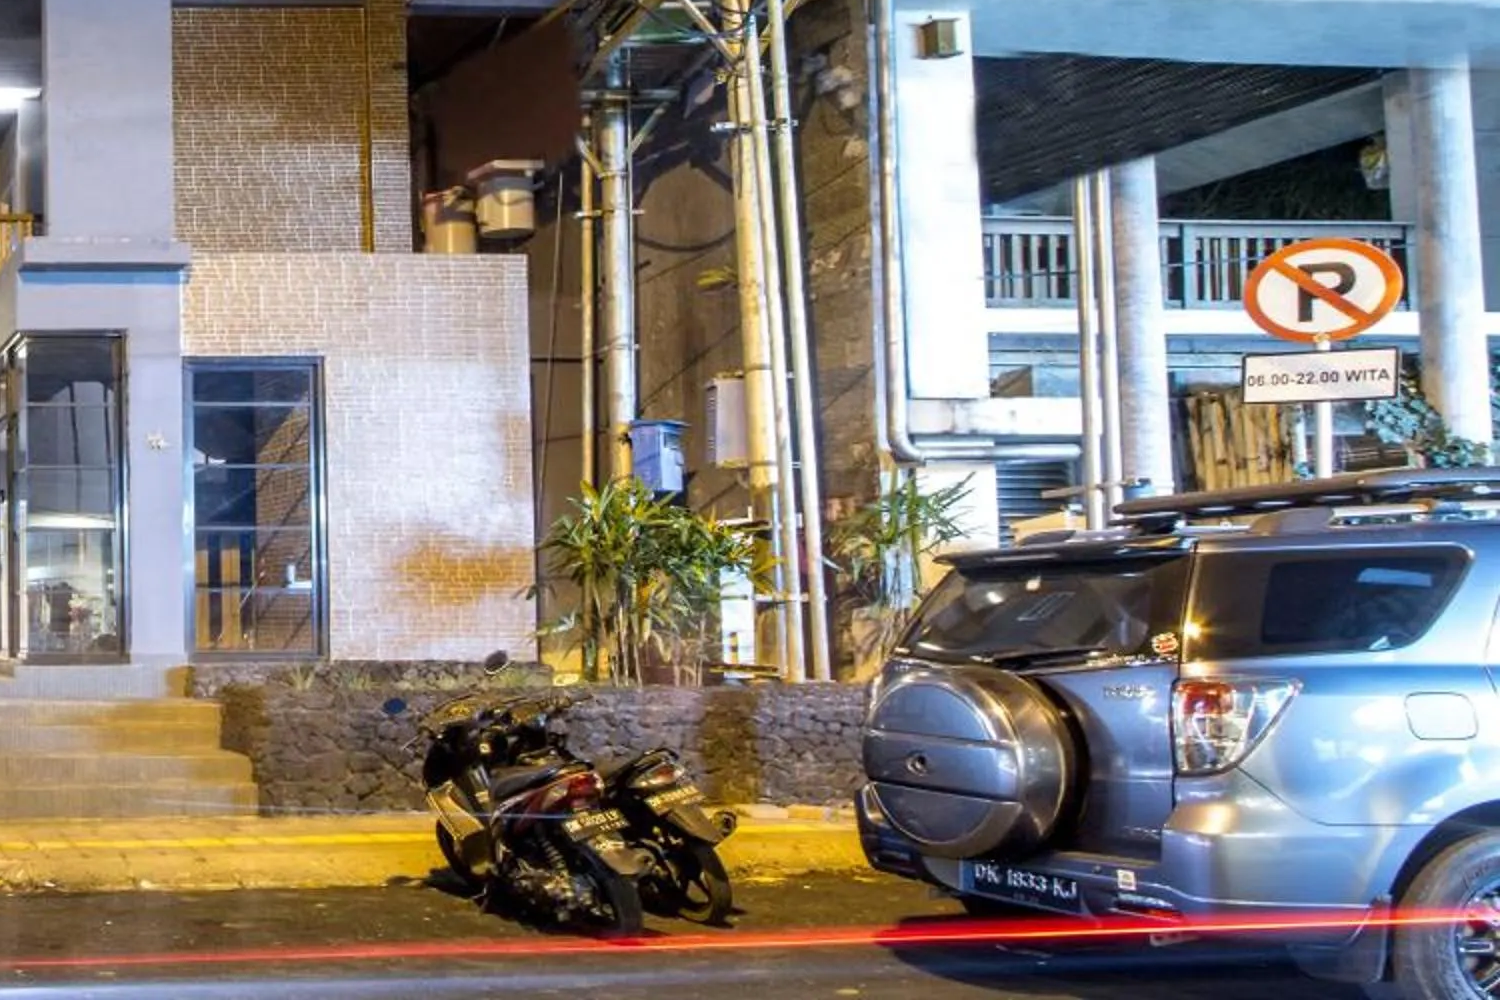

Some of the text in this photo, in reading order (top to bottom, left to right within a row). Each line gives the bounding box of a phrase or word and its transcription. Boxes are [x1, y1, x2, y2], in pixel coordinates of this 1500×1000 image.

[1297, 261, 1356, 322] P
[1345, 368, 1390, 382] WITA
[974, 862, 1000, 884] DK
[1053, 877, 1077, 898] KJ
